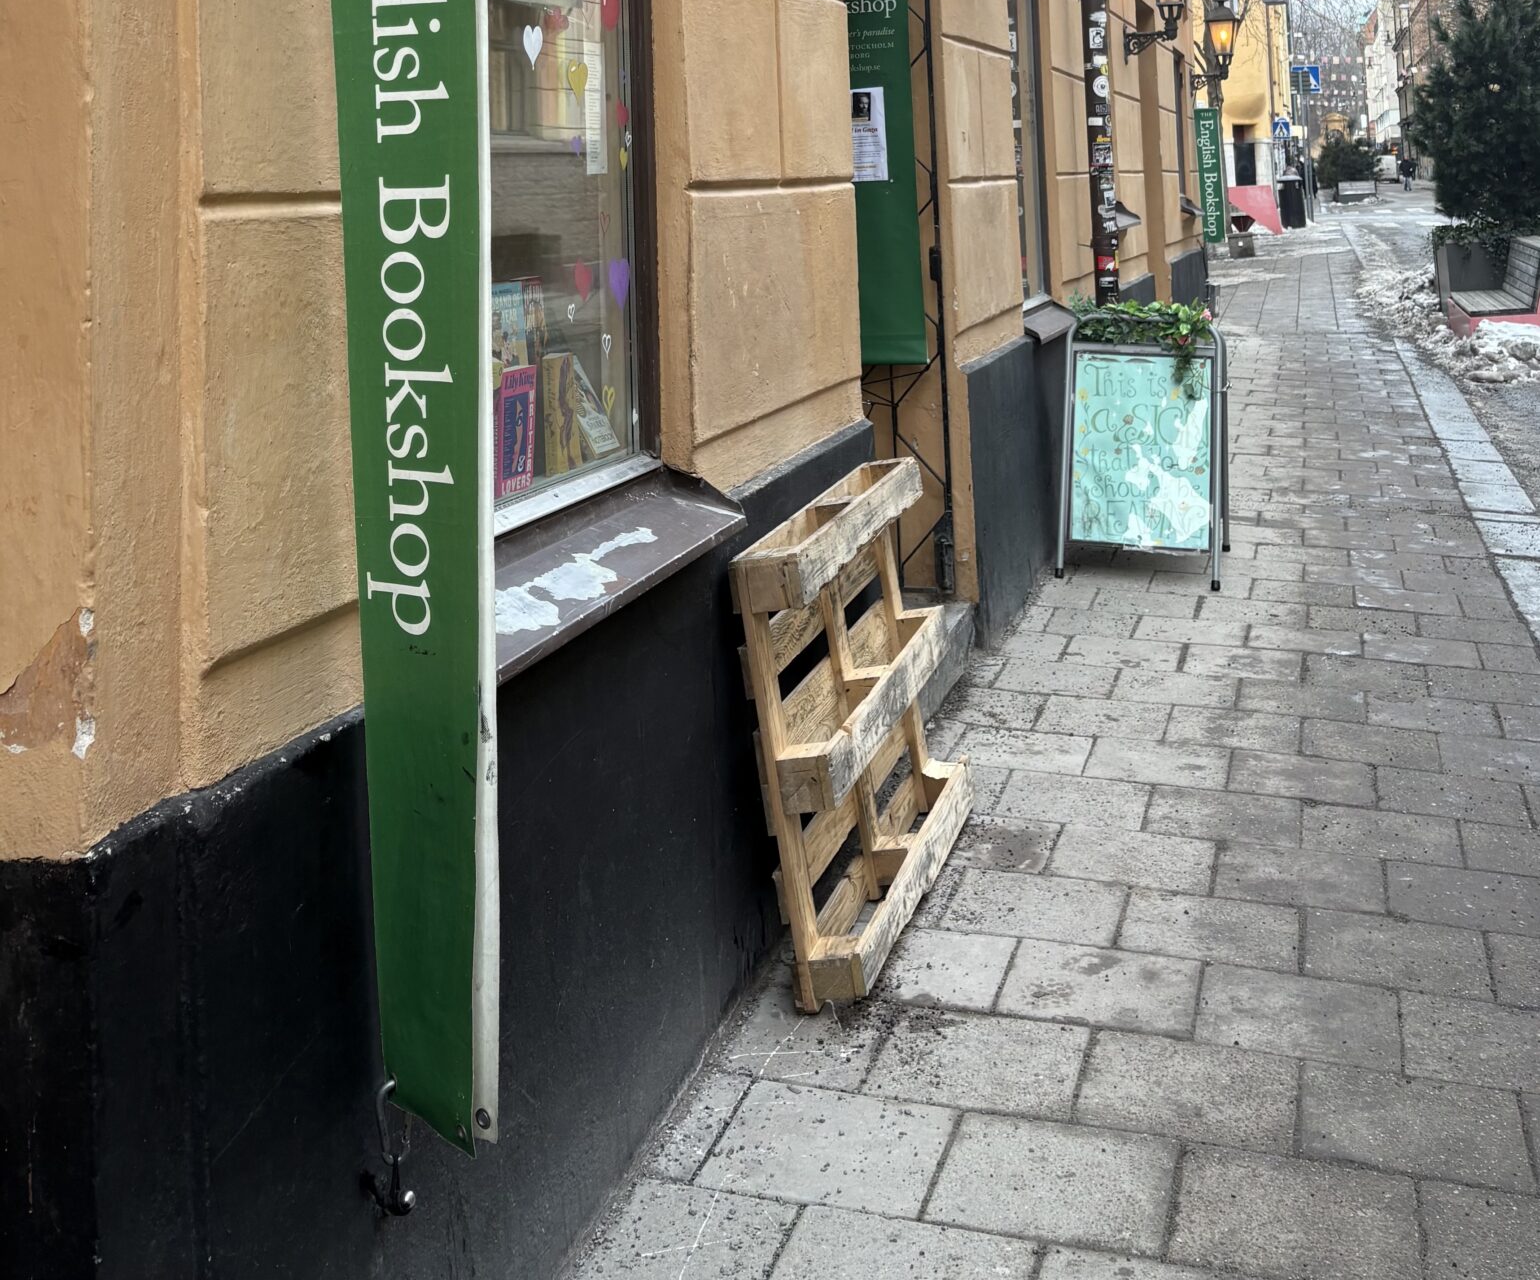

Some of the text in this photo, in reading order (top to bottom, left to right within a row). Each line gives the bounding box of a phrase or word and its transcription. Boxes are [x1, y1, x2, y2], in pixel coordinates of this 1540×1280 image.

[849, 41, 895, 51] TOCKHOLM
[1197, 119, 1220, 237] English Bookshop
[1084, 363, 1167, 398] This is
[366, 174, 455, 636] Bookshop
[502, 473, 531, 496] LOVERS
